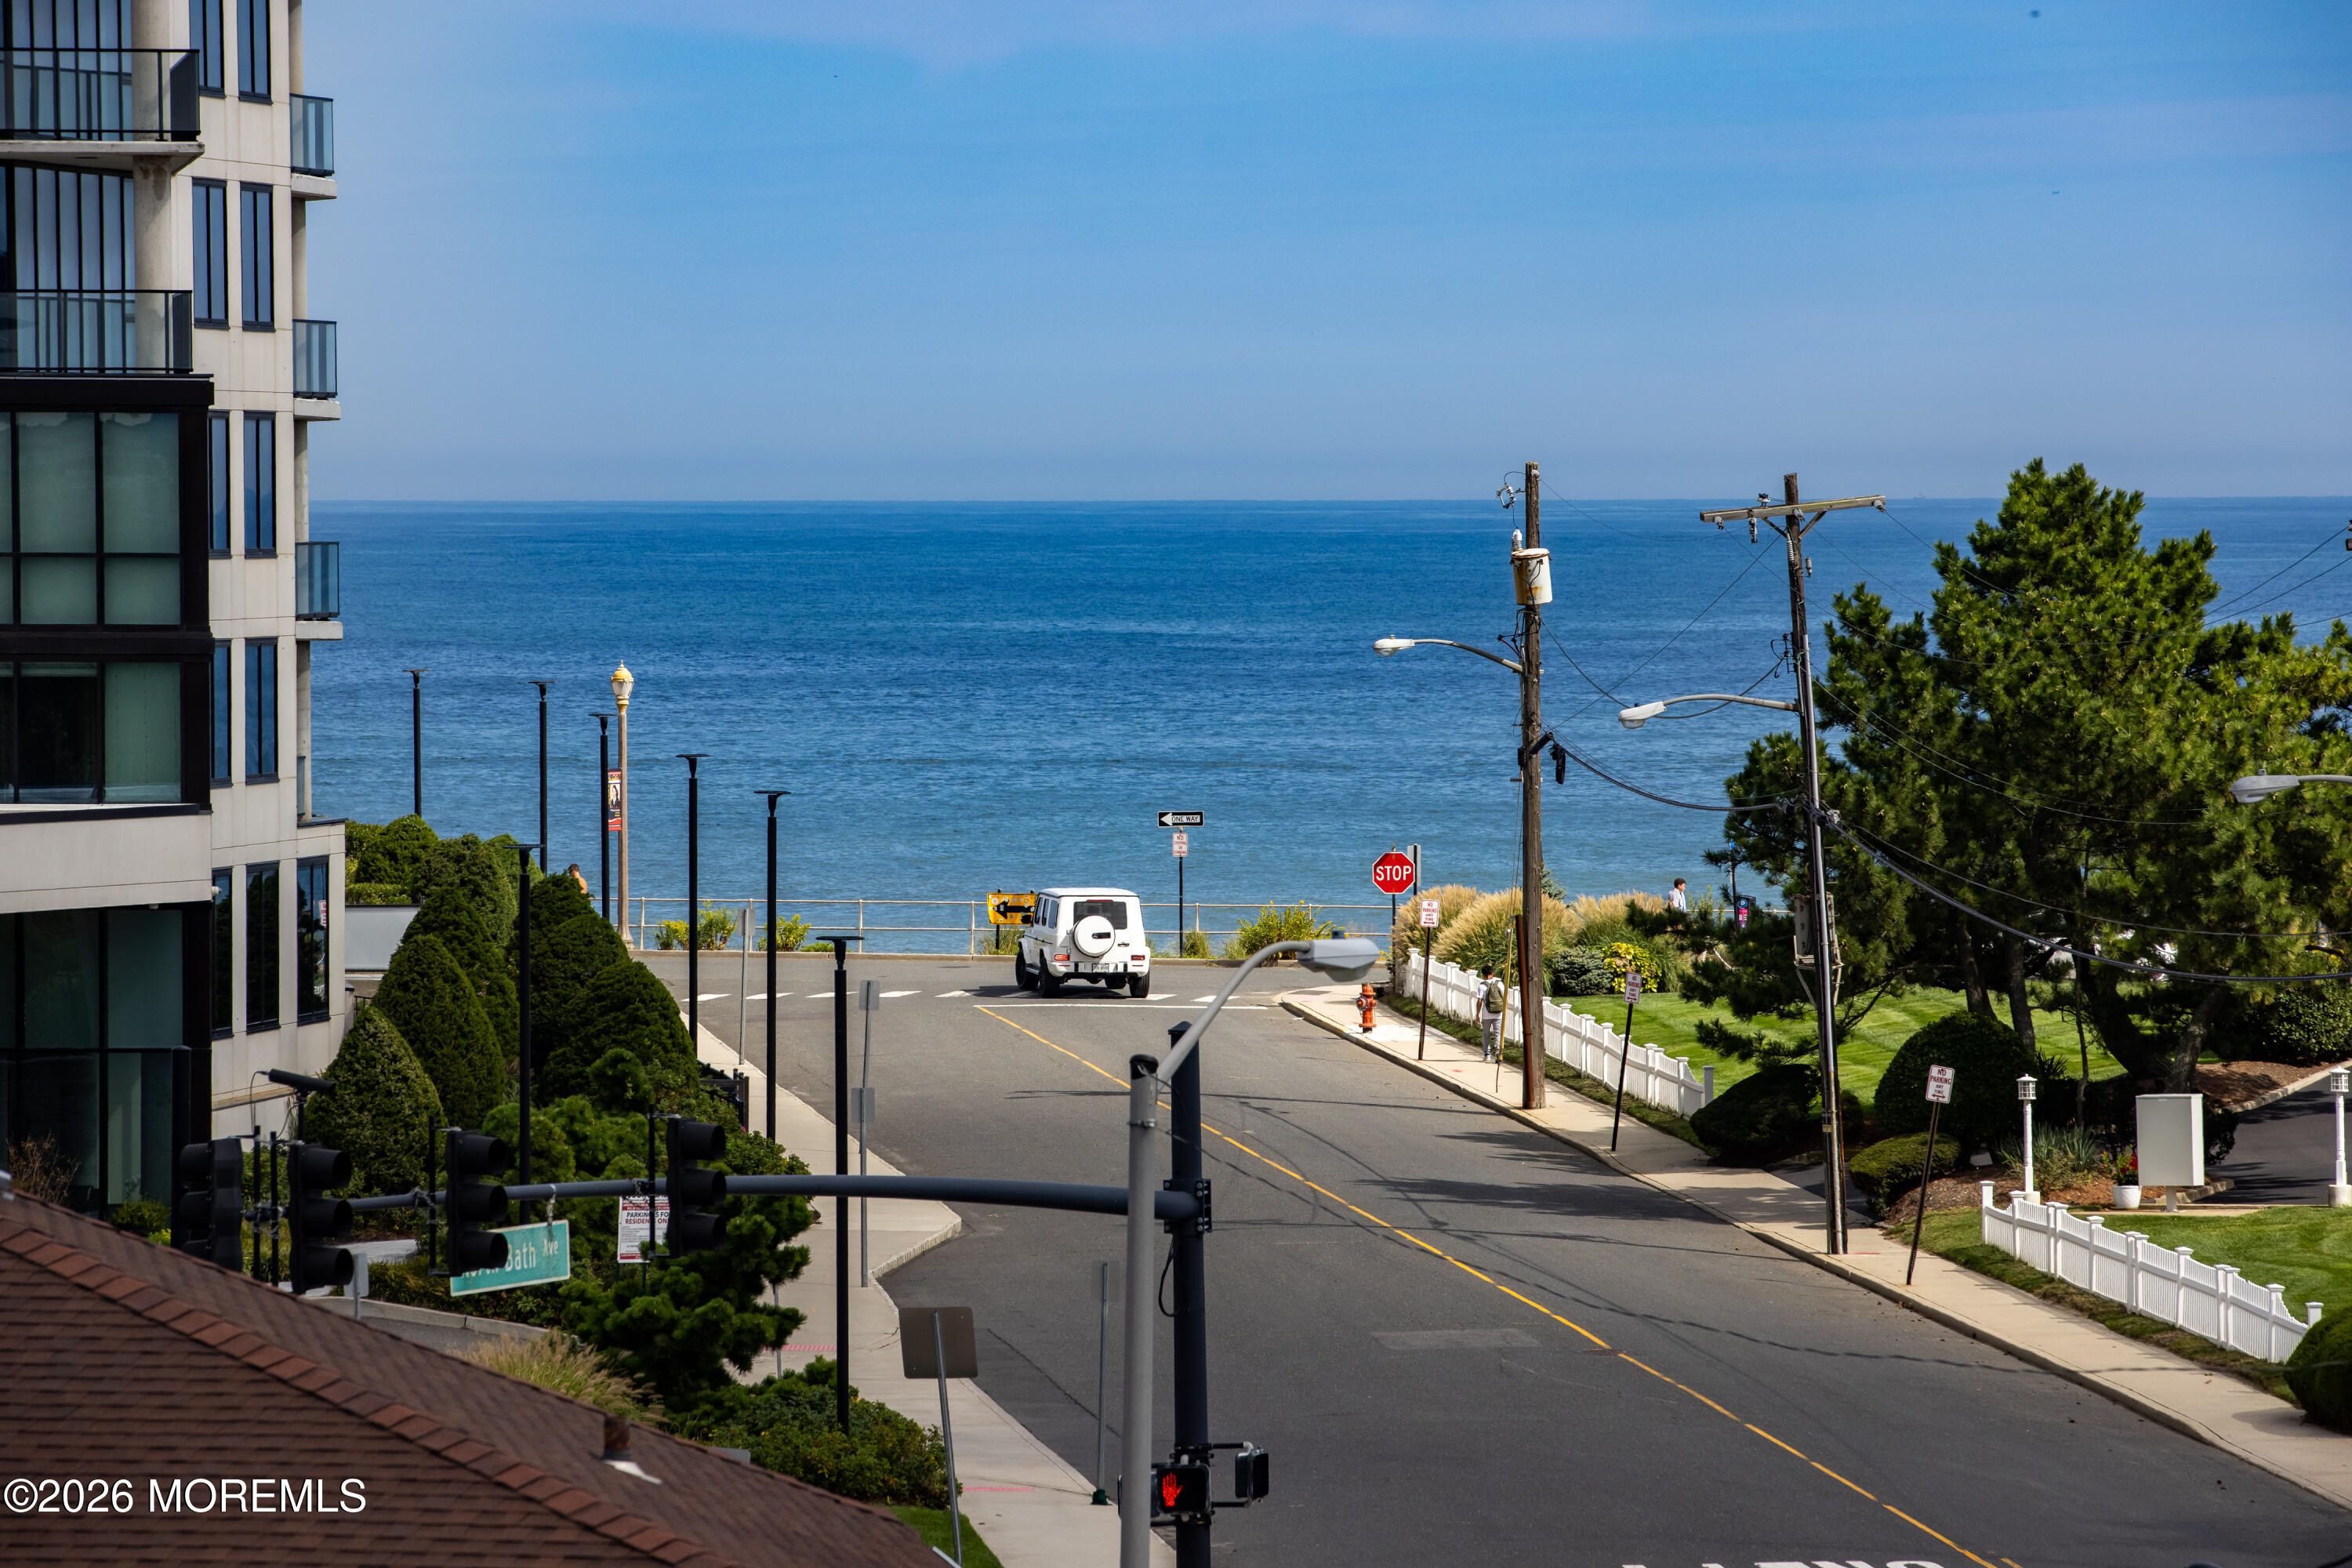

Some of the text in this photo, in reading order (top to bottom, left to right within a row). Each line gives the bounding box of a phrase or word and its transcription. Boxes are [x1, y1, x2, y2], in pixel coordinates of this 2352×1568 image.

[1376, 866, 1412, 881] STOP
[1930, 1076, 1951, 1085] PARKING
[543, 1238, 559, 1256] Ave
